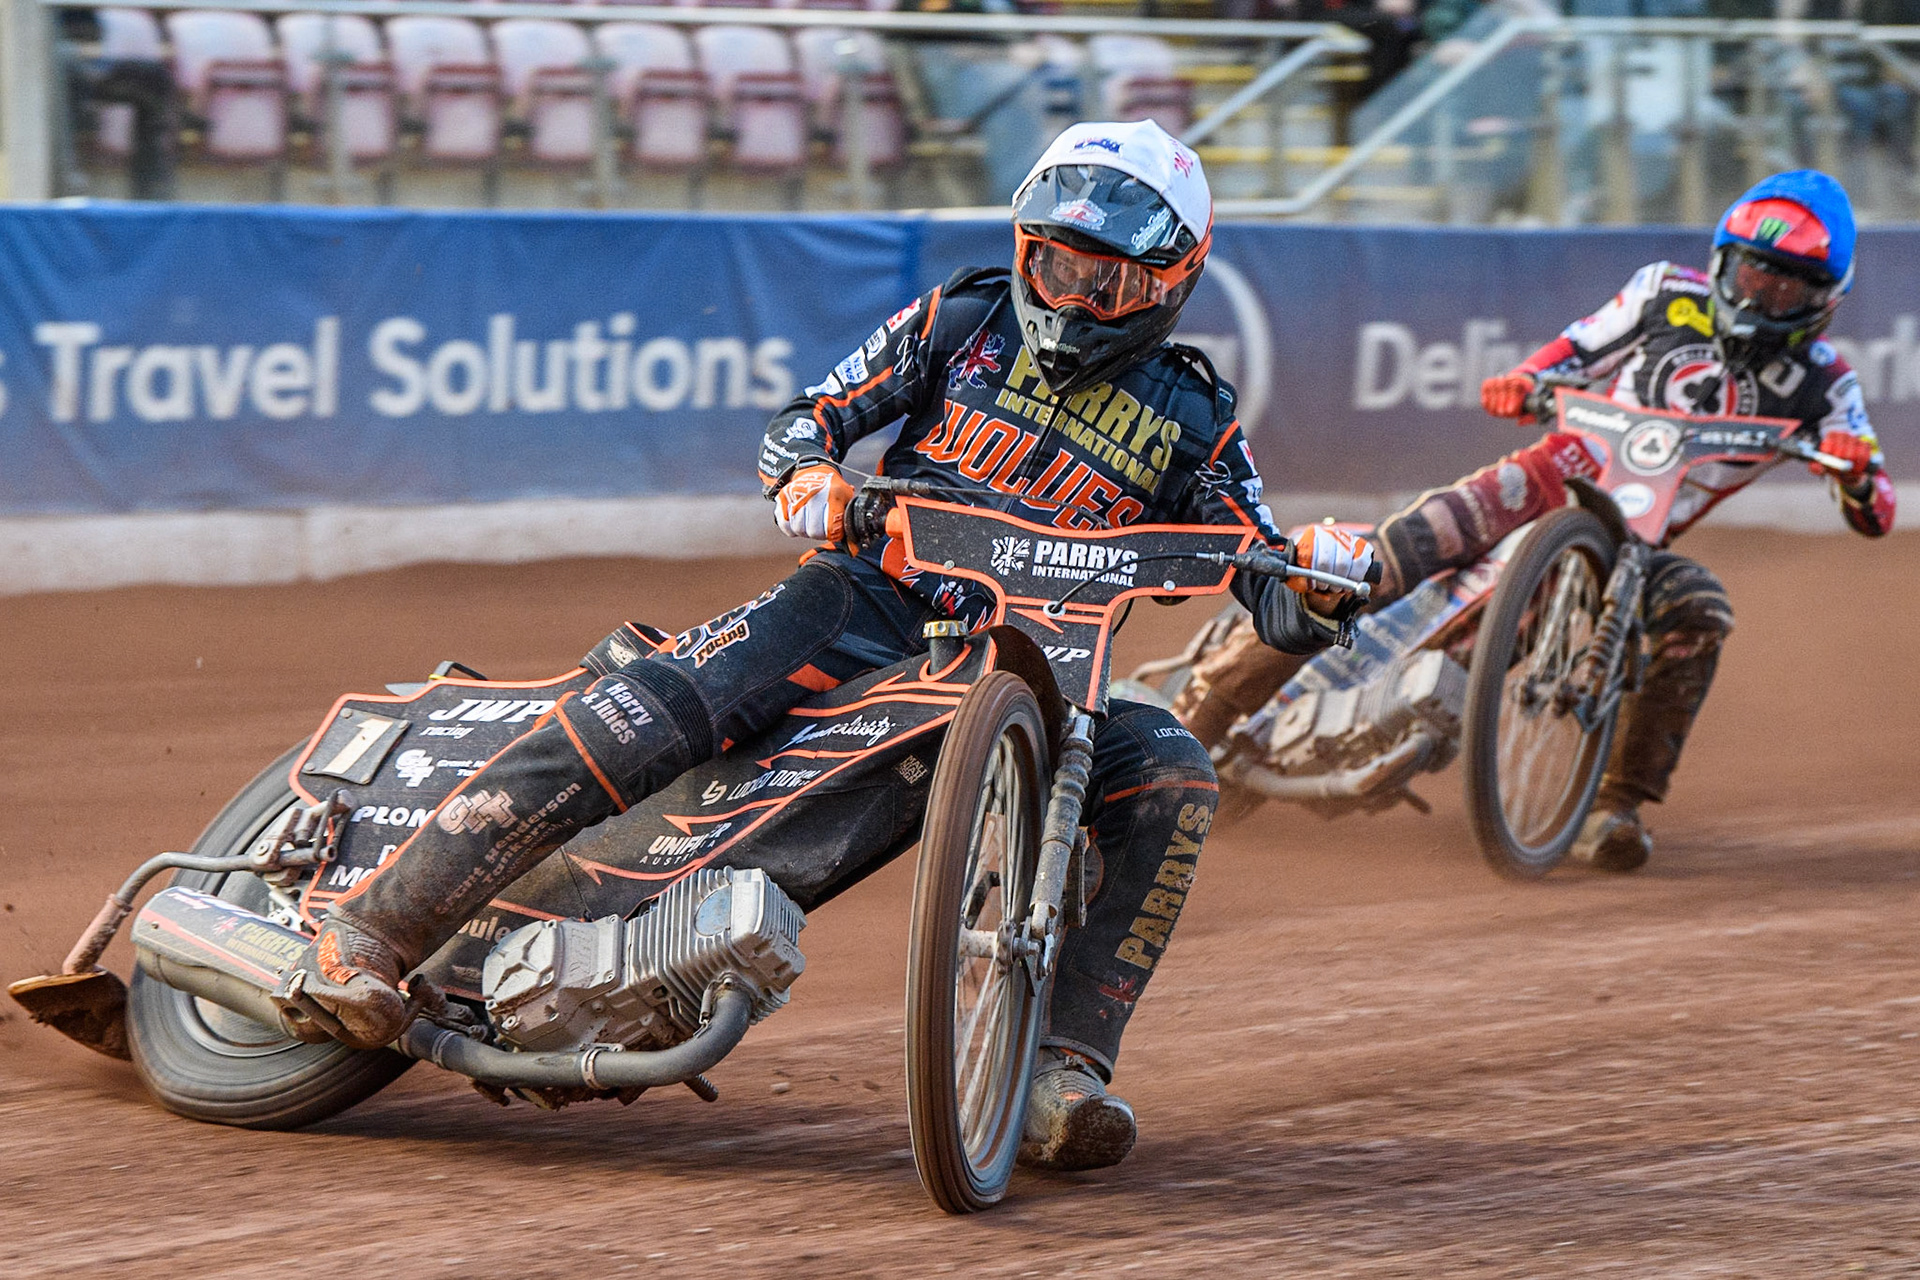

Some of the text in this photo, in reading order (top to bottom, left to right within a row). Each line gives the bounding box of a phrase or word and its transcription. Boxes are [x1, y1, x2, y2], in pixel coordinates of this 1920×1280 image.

[35, 317, 338, 423] Travel
[370, 314, 795, 415] Solutions
[1032, 565, 1135, 588] INTERNATONAL
[1033, 540, 1139, 574] PARRYS
[692, 619, 750, 668] racing
[1040, 645, 1091, 663] WP
[427, 699, 557, 722] JWP
[581, 692, 636, 744] & Jules
[605, 682, 653, 726] Harry
[323, 718, 394, 774] 1
[484, 782, 582, 864] Henderson
[1115, 803, 1210, 970] PARRYS
[232, 922, 309, 962] PARRYS
